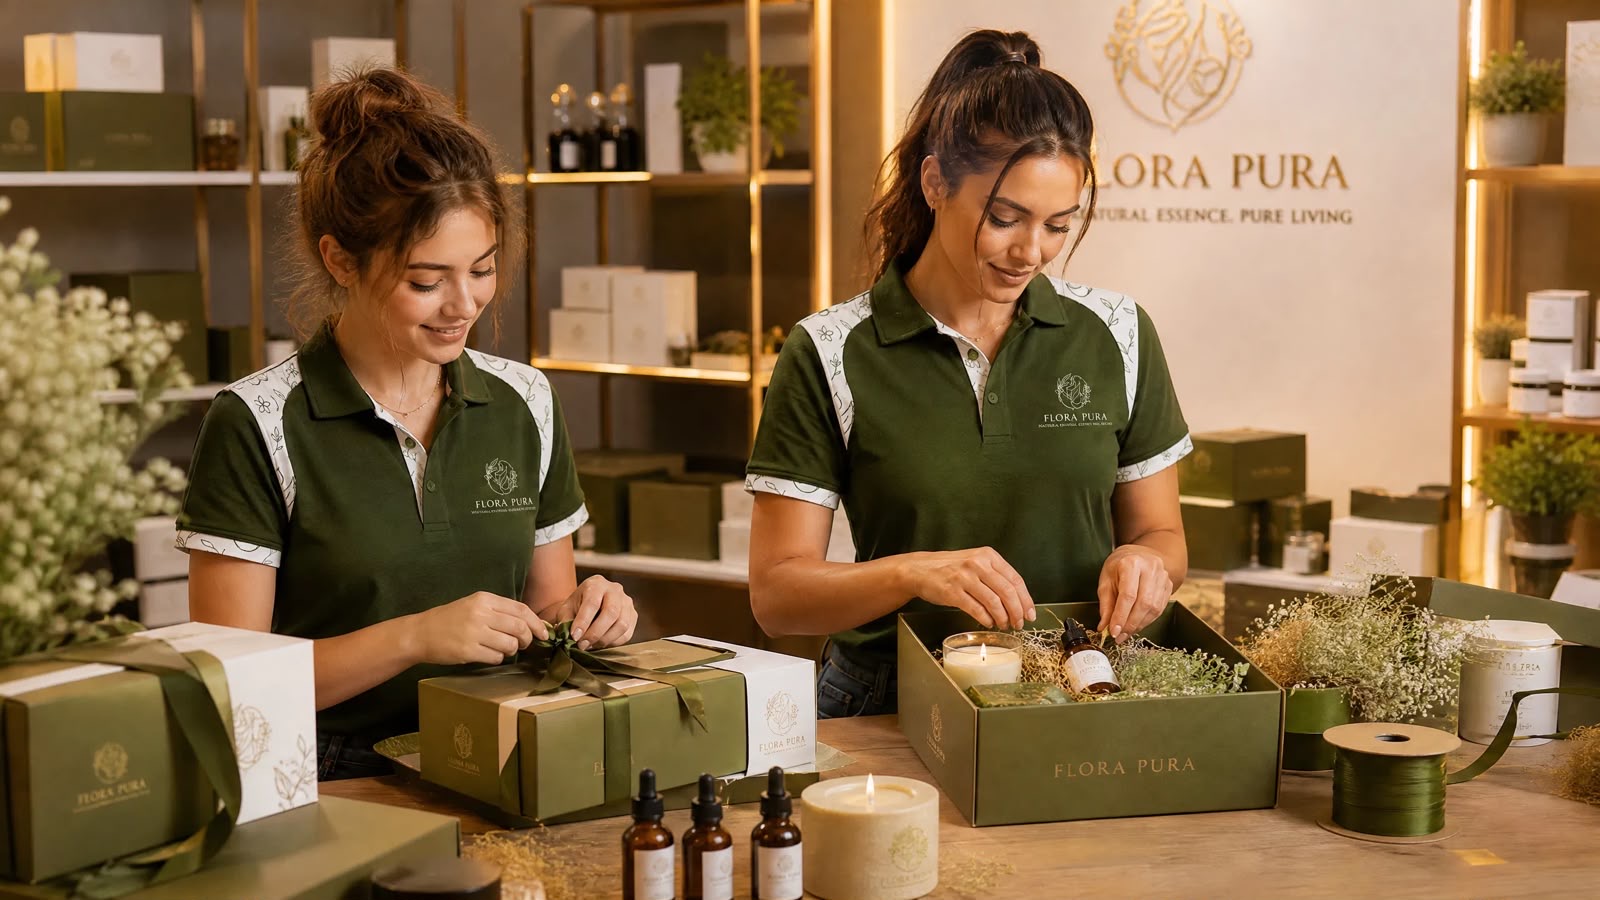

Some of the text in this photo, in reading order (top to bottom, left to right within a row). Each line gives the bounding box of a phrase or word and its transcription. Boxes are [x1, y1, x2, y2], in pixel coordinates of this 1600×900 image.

[1093, 153, 1350, 190] LORA PURA
[1074, 208, 1148, 222] TURAL
[1240, 208, 1284, 223] PURE
[1290, 209, 1353, 225] LIVING
[1044, 412, 1108, 422] FLORA PURA
[475, 497, 534, 509] FLORA PURA
[759, 740, 784, 753] FLORA
[786, 735, 806, 746] PURA
[1053, 757, 1196, 778] FLORA PURA
